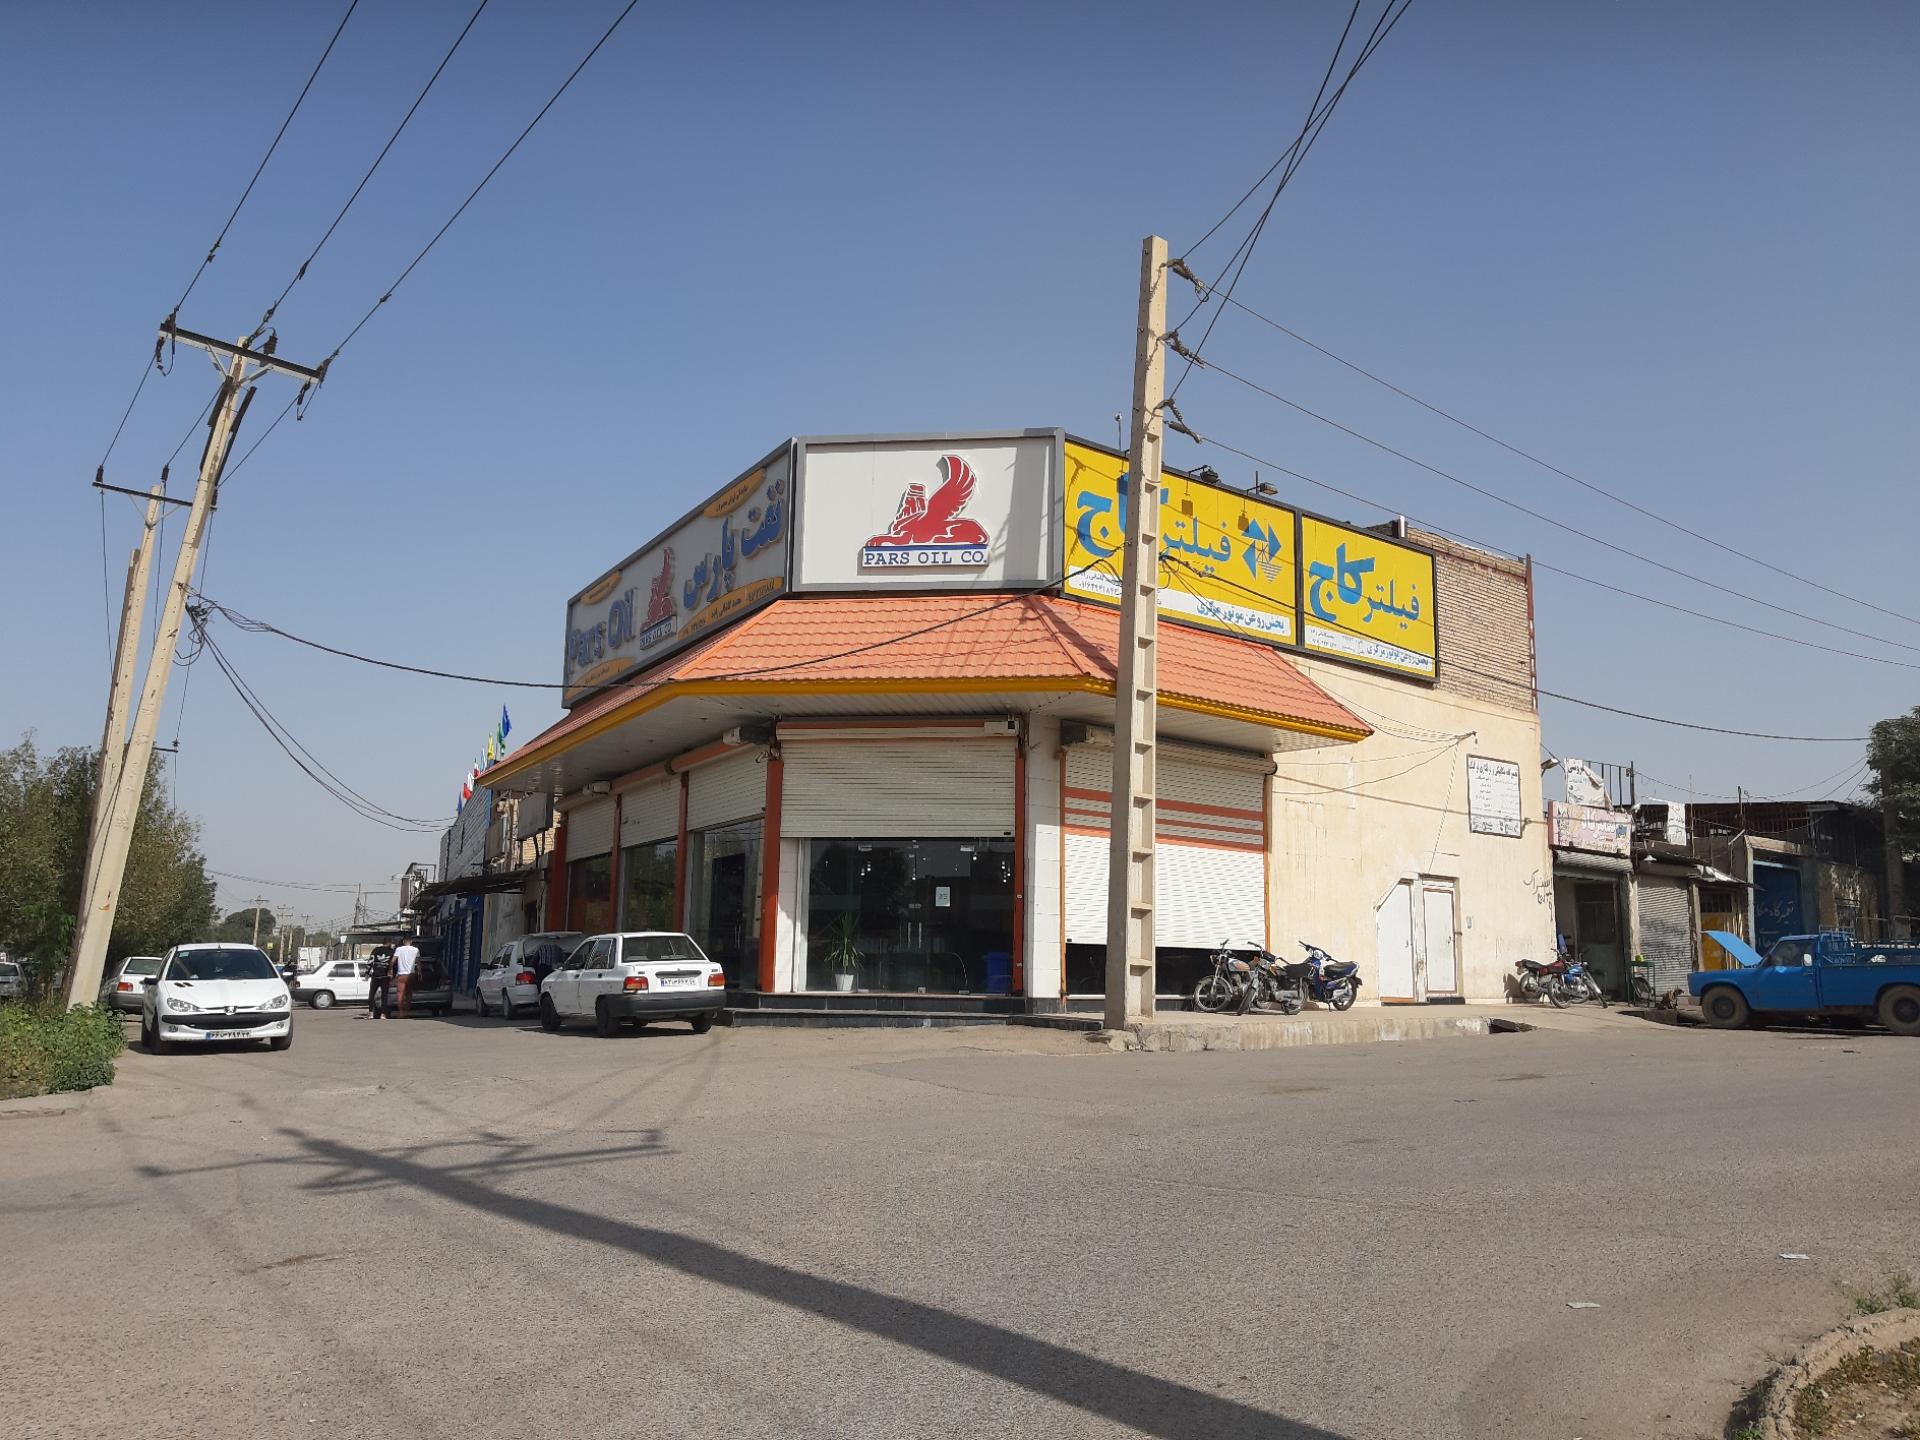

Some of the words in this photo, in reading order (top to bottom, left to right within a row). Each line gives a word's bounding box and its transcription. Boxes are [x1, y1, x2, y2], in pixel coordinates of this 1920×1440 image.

[741, 479, 785, 558] نفت
[683, 515, 737, 609] پارس
[864, 553, 910, 565] PARS
[918, 552, 952, 564] OIL
[961, 551, 987, 563] CO.
[1308, 543, 1375, 623] کاج
[608, 587, 638, 651] Oil
[1362, 578, 1420, 630] فیلتر
